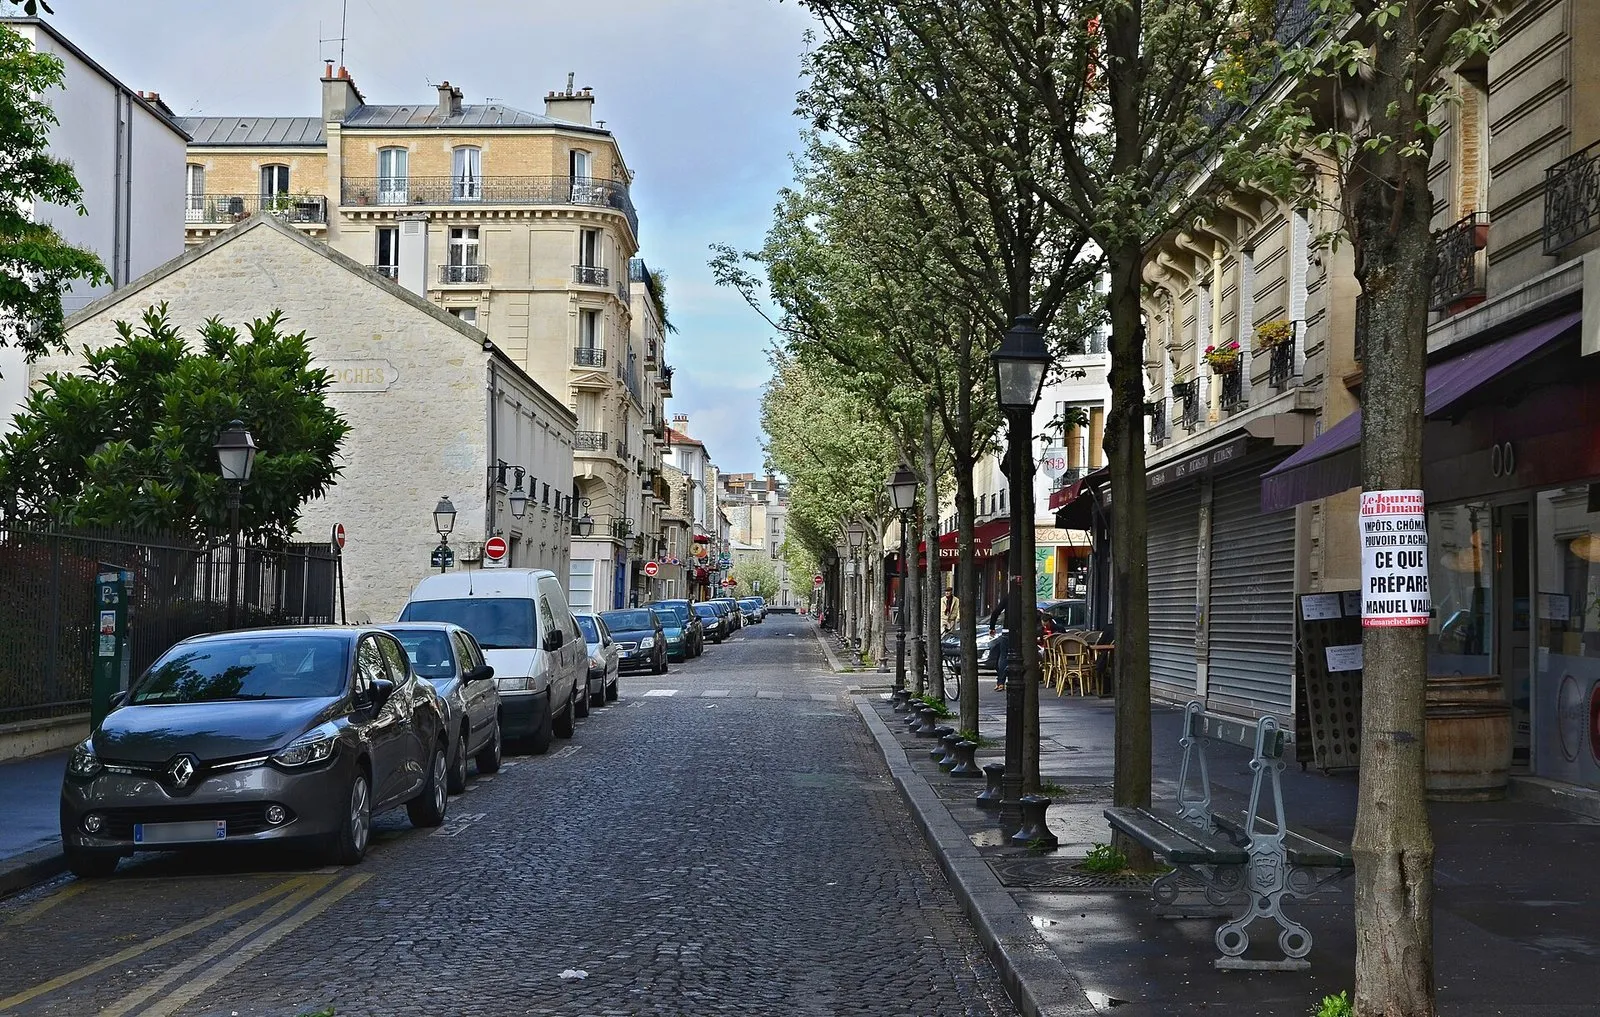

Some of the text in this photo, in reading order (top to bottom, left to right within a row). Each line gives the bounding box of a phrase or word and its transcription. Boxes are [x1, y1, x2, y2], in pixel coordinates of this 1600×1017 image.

[332, 368, 385, 384] OCHES
[1375, 493, 1423, 504] Journa
[1362, 503, 1424, 515] du Dimanc
[1396, 518, 1425, 531] CHÔMA
[1366, 534, 1426, 546] POUVOIR D'ACHA
[939, 549, 960, 557] ISTR
[983, 549, 993, 557] VI
[1375, 550, 1423, 570] CE QUE
[1370, 573, 1428, 594] PRÉPARE
[1366, 600, 1408, 614] MANUEL
[1370, 618, 1405, 626] dimanche
[216, 829, 225, 837] 75
